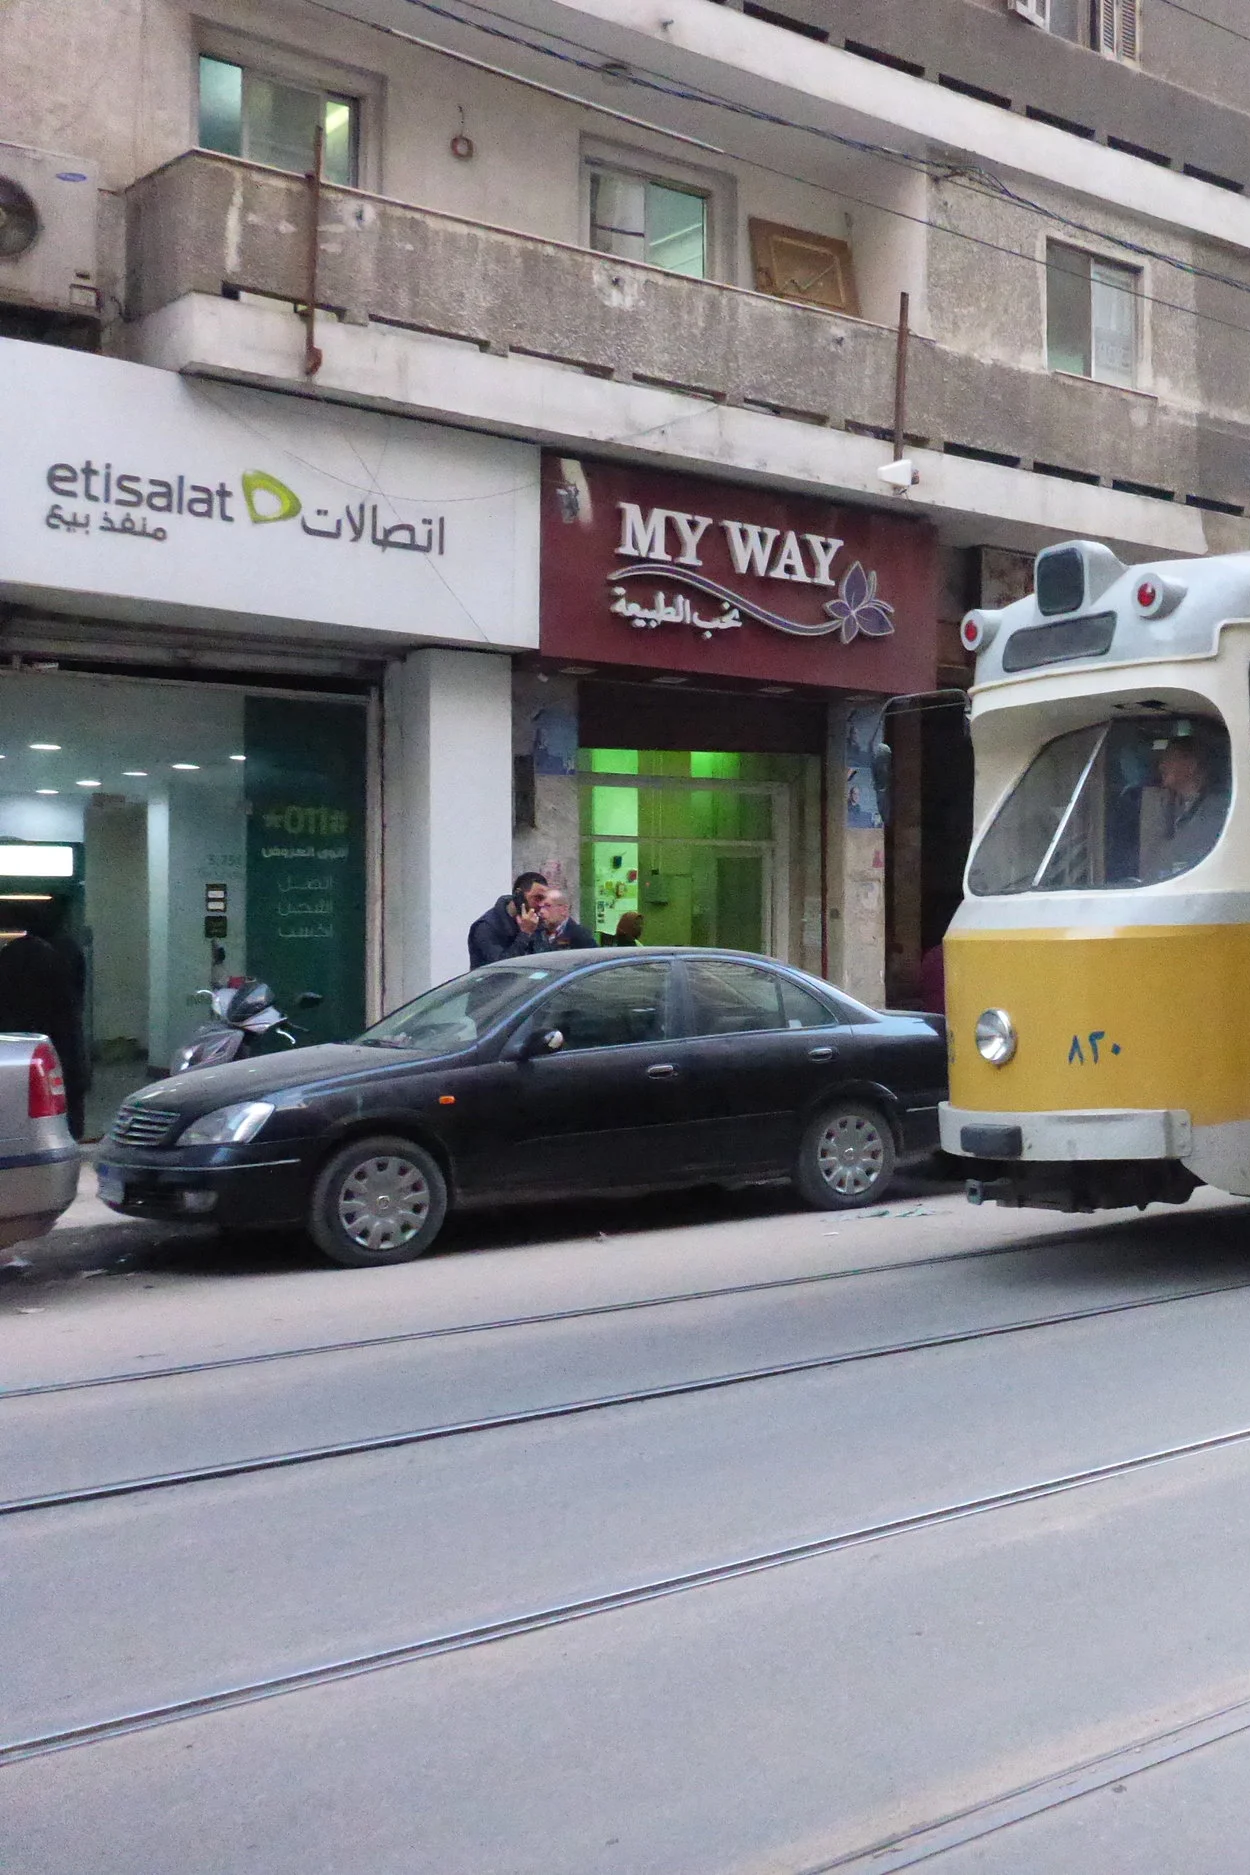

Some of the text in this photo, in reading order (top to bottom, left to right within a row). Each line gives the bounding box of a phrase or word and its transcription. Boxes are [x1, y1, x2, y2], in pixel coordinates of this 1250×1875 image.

[47, 460, 235, 522] etisalat
[46, 504, 168, 541] منفذ بيع
[301, 504, 445, 555] اتصالات
[615, 501, 844, 587] MY WAY
[610, 586, 691, 629] الطبيعة
